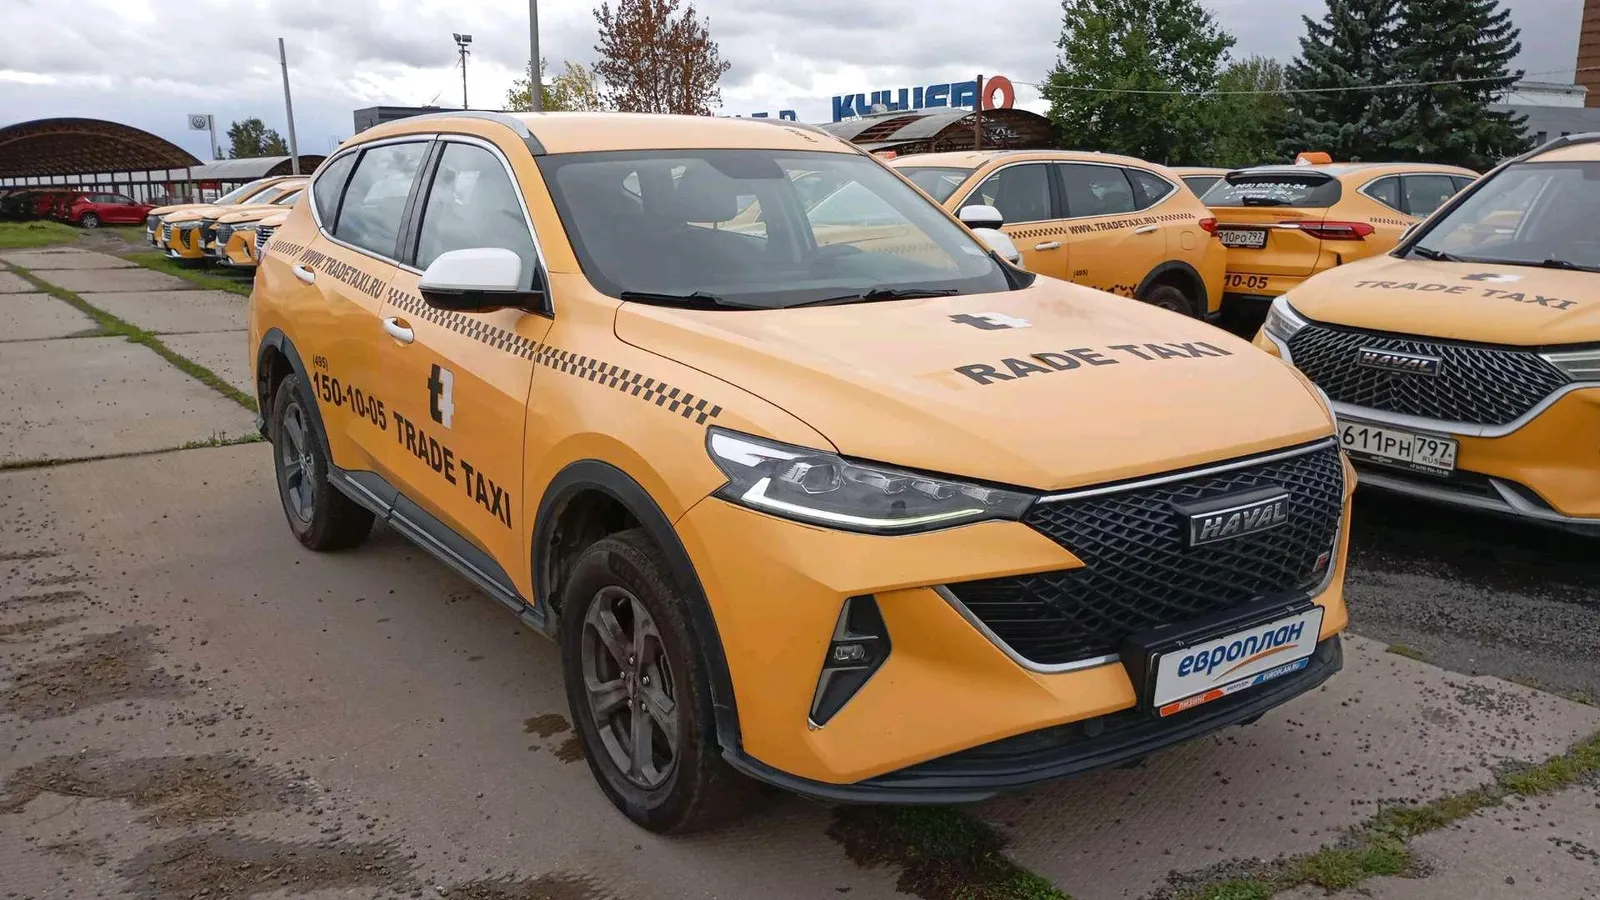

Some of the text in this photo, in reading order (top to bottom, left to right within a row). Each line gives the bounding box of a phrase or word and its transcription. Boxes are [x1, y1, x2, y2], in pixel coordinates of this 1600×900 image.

[1069, 216, 1157, 234] WWW.TRADETAXI.RU
[299, 248, 387, 300] WWW.TRADETAXI.RU
[1355, 280, 1578, 310] TRADE TAXI
[312, 354, 329, 373] (495)
[1107, 341, 1233, 361] TAXI
[1363, 352, 1433, 373] HAVAL
[313, 371, 387, 431] 150-10-05
[1339, 425, 1450, 459] 611РН 797
[393, 410, 512, 530] TRADE TAXI
[1422, 455, 1439, 466] RUS
[1200, 502, 1286, 540] HAVAL
[1177, 620, 1305, 677] европлан
[1263, 662, 1300, 680] EUROPLAN.RU
